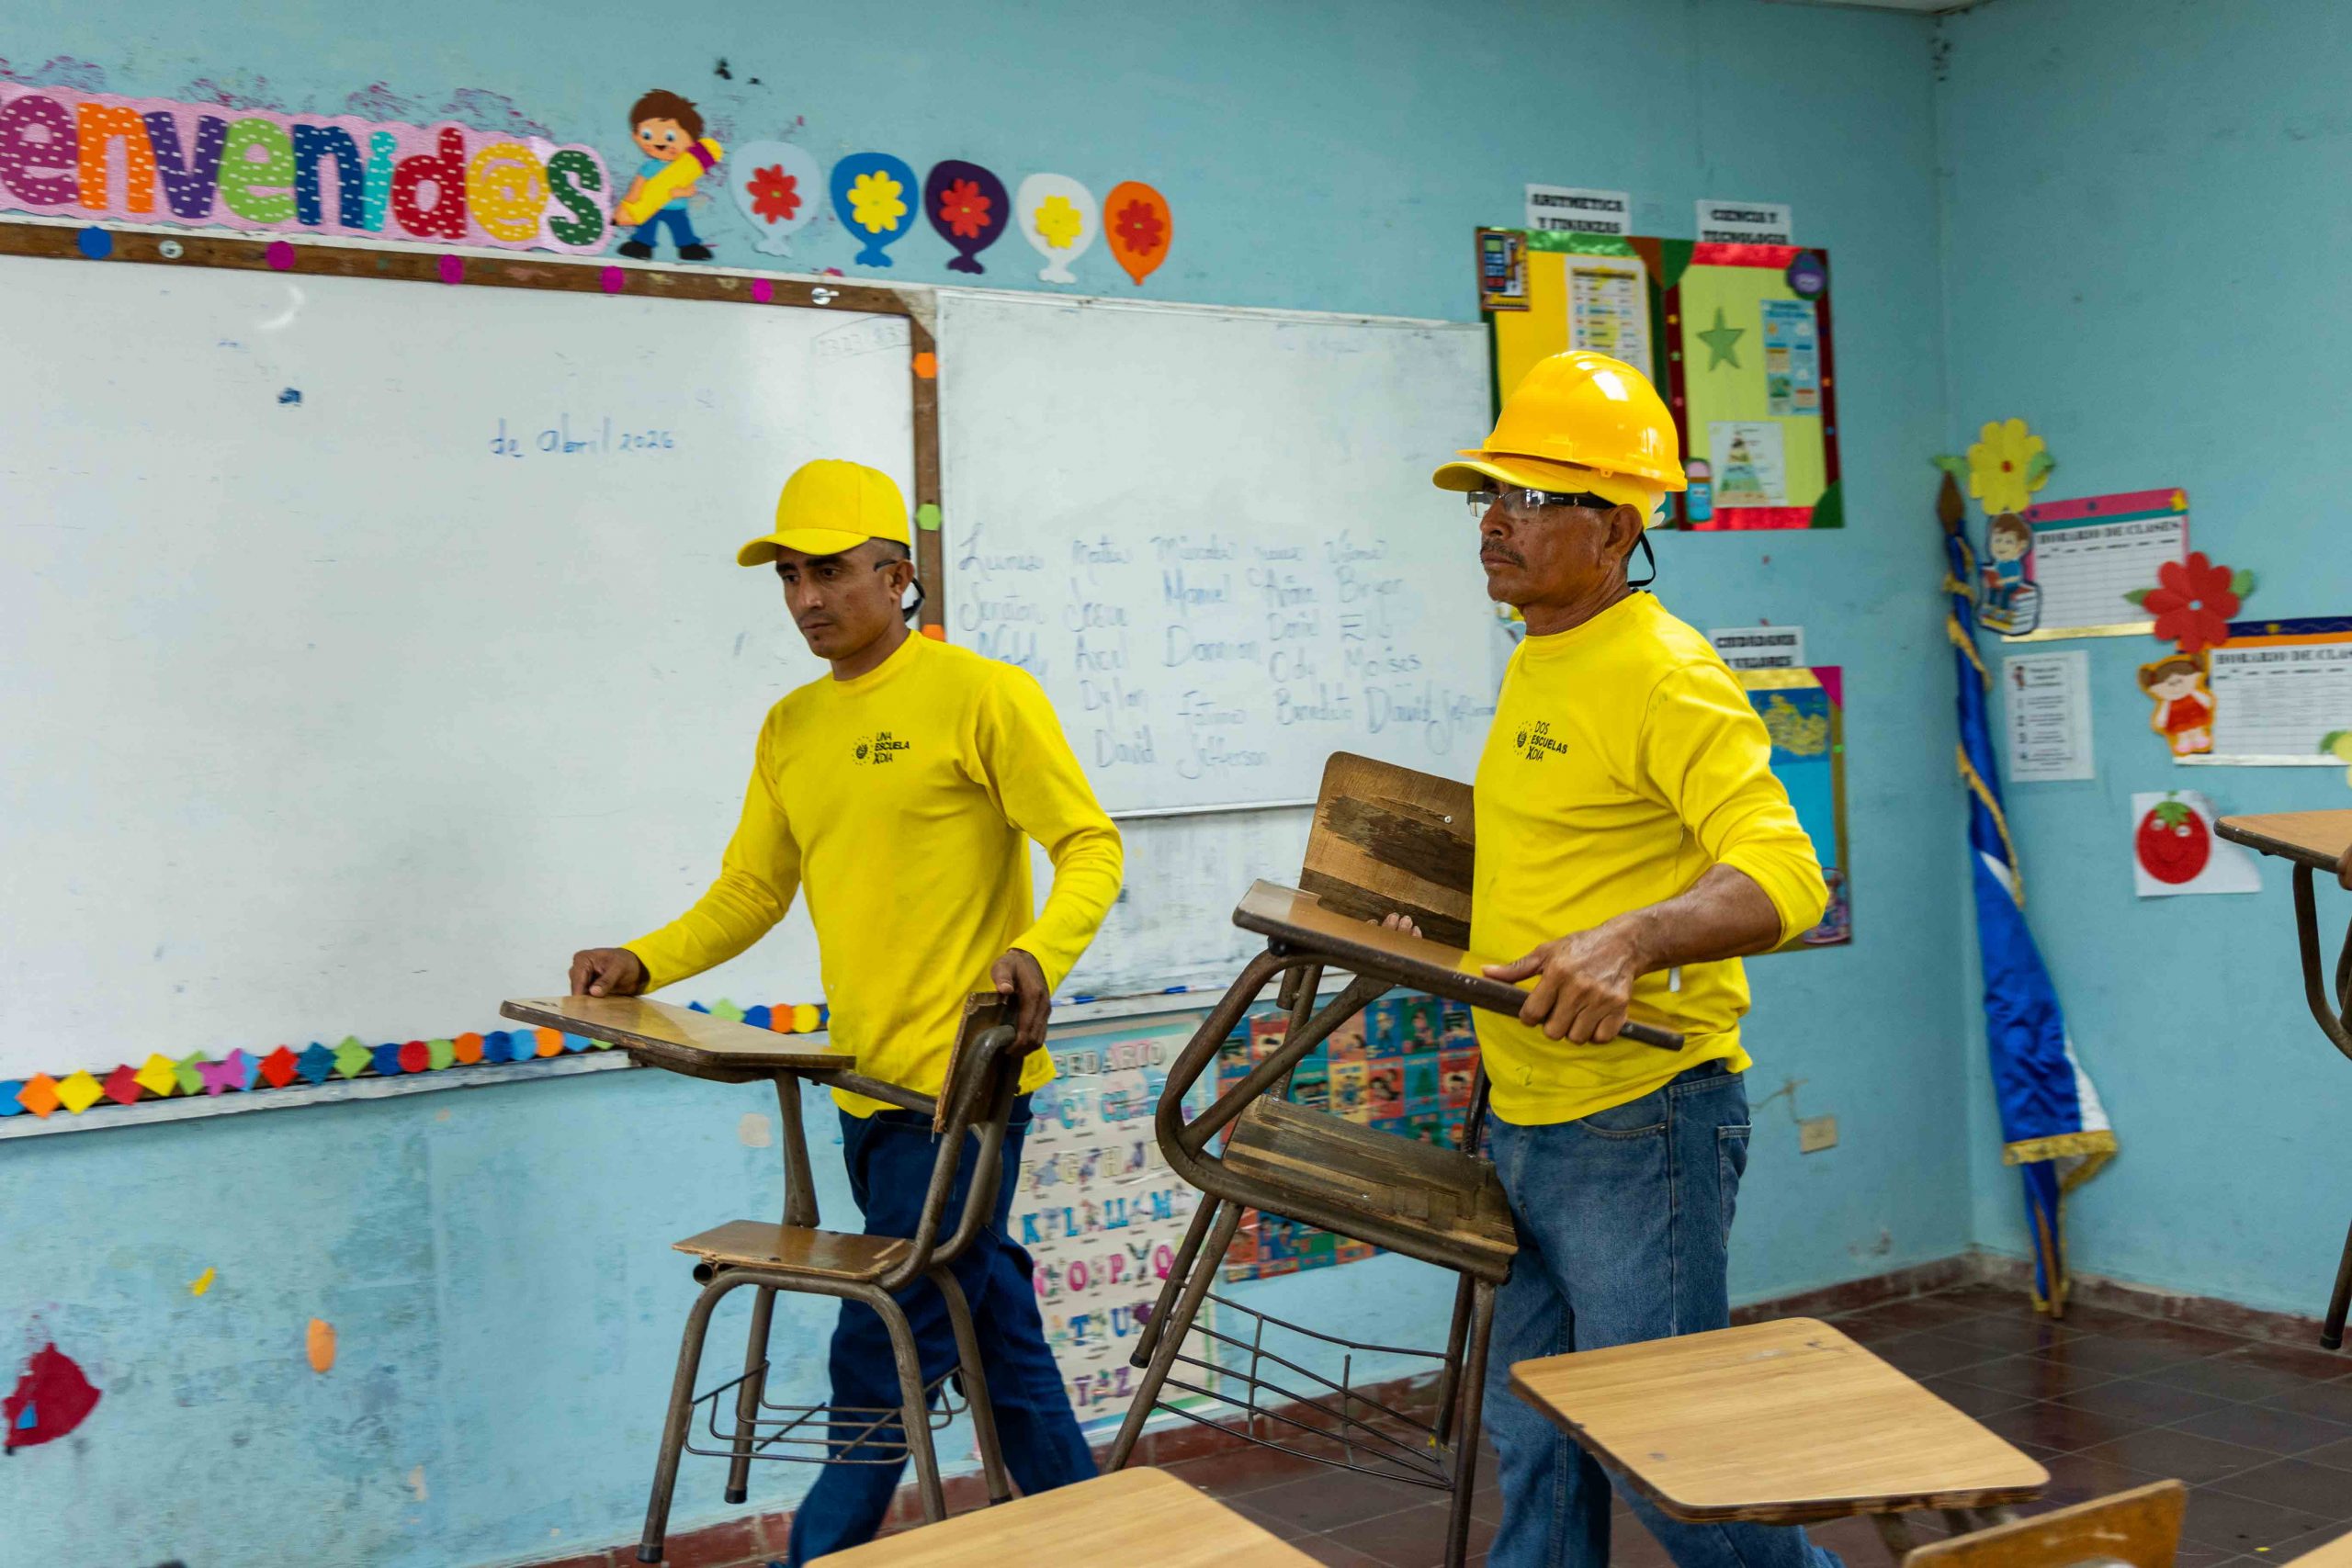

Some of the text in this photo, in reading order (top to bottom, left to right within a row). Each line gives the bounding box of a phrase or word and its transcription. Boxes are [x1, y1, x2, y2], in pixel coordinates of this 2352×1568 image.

[490, 417, 525, 457] de
[876, 731, 892, 742] UNA
[1534, 720, 1551, 736] DOS
[874, 740, 910, 751] ESCUELA
[1531, 734, 1568, 754] ESCUELAS
[1063, 1207, 1078, 1236] L
[1069, 1260, 1087, 1292] O
[1110, 1254, 1125, 1284] P
[1111, 1307, 1130, 1337] U
